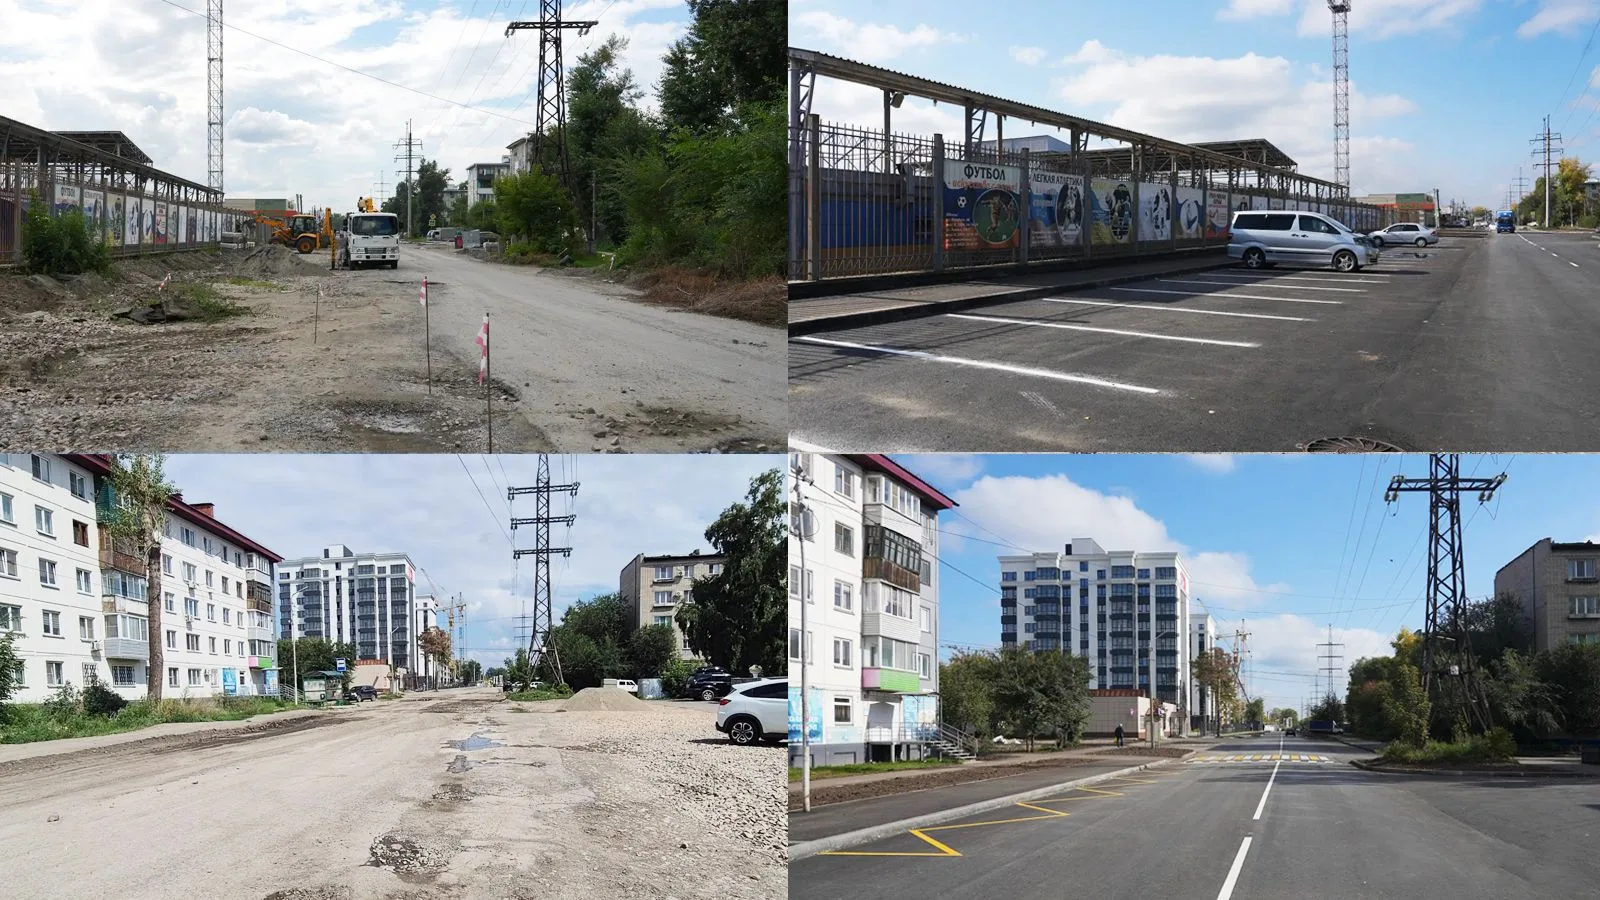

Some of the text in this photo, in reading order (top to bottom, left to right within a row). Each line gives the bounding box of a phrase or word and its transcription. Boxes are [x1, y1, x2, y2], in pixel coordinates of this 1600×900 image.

[964, 164, 1006, 180] ФУТБОЛ
[1032, 173, 1055, 184] ЛЕГКАЯ
[1056, 175, 1083, 187] АТЛЕТИКА
